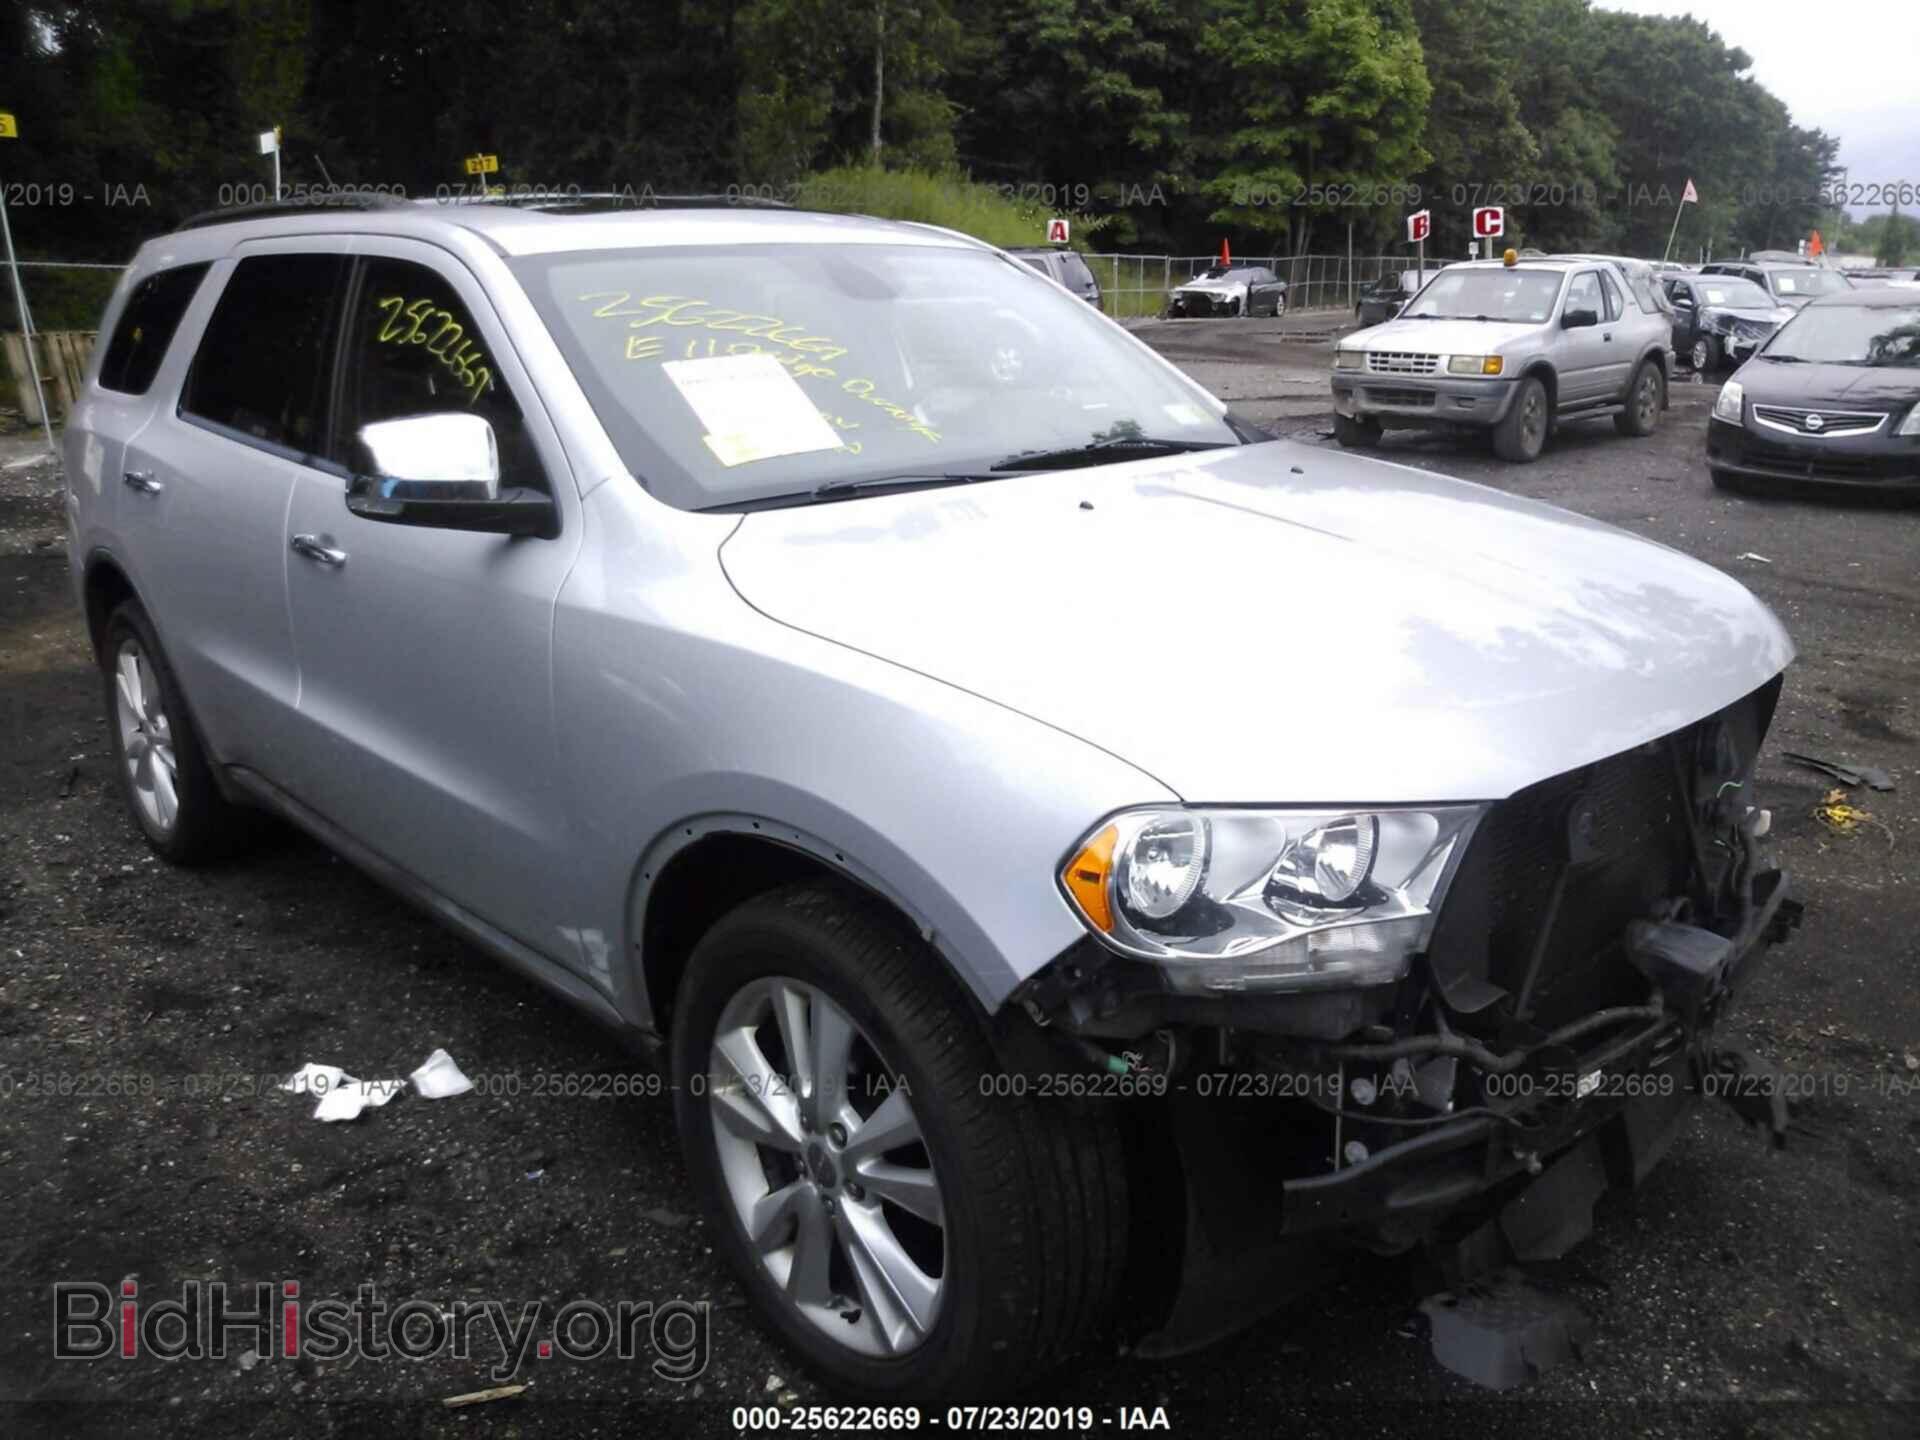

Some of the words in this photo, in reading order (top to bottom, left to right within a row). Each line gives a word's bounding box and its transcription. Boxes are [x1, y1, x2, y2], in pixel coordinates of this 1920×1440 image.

[1050, 221, 1066, 241] A
[1413, 214, 1427, 240] B
[1476, 208, 1501, 236] C
